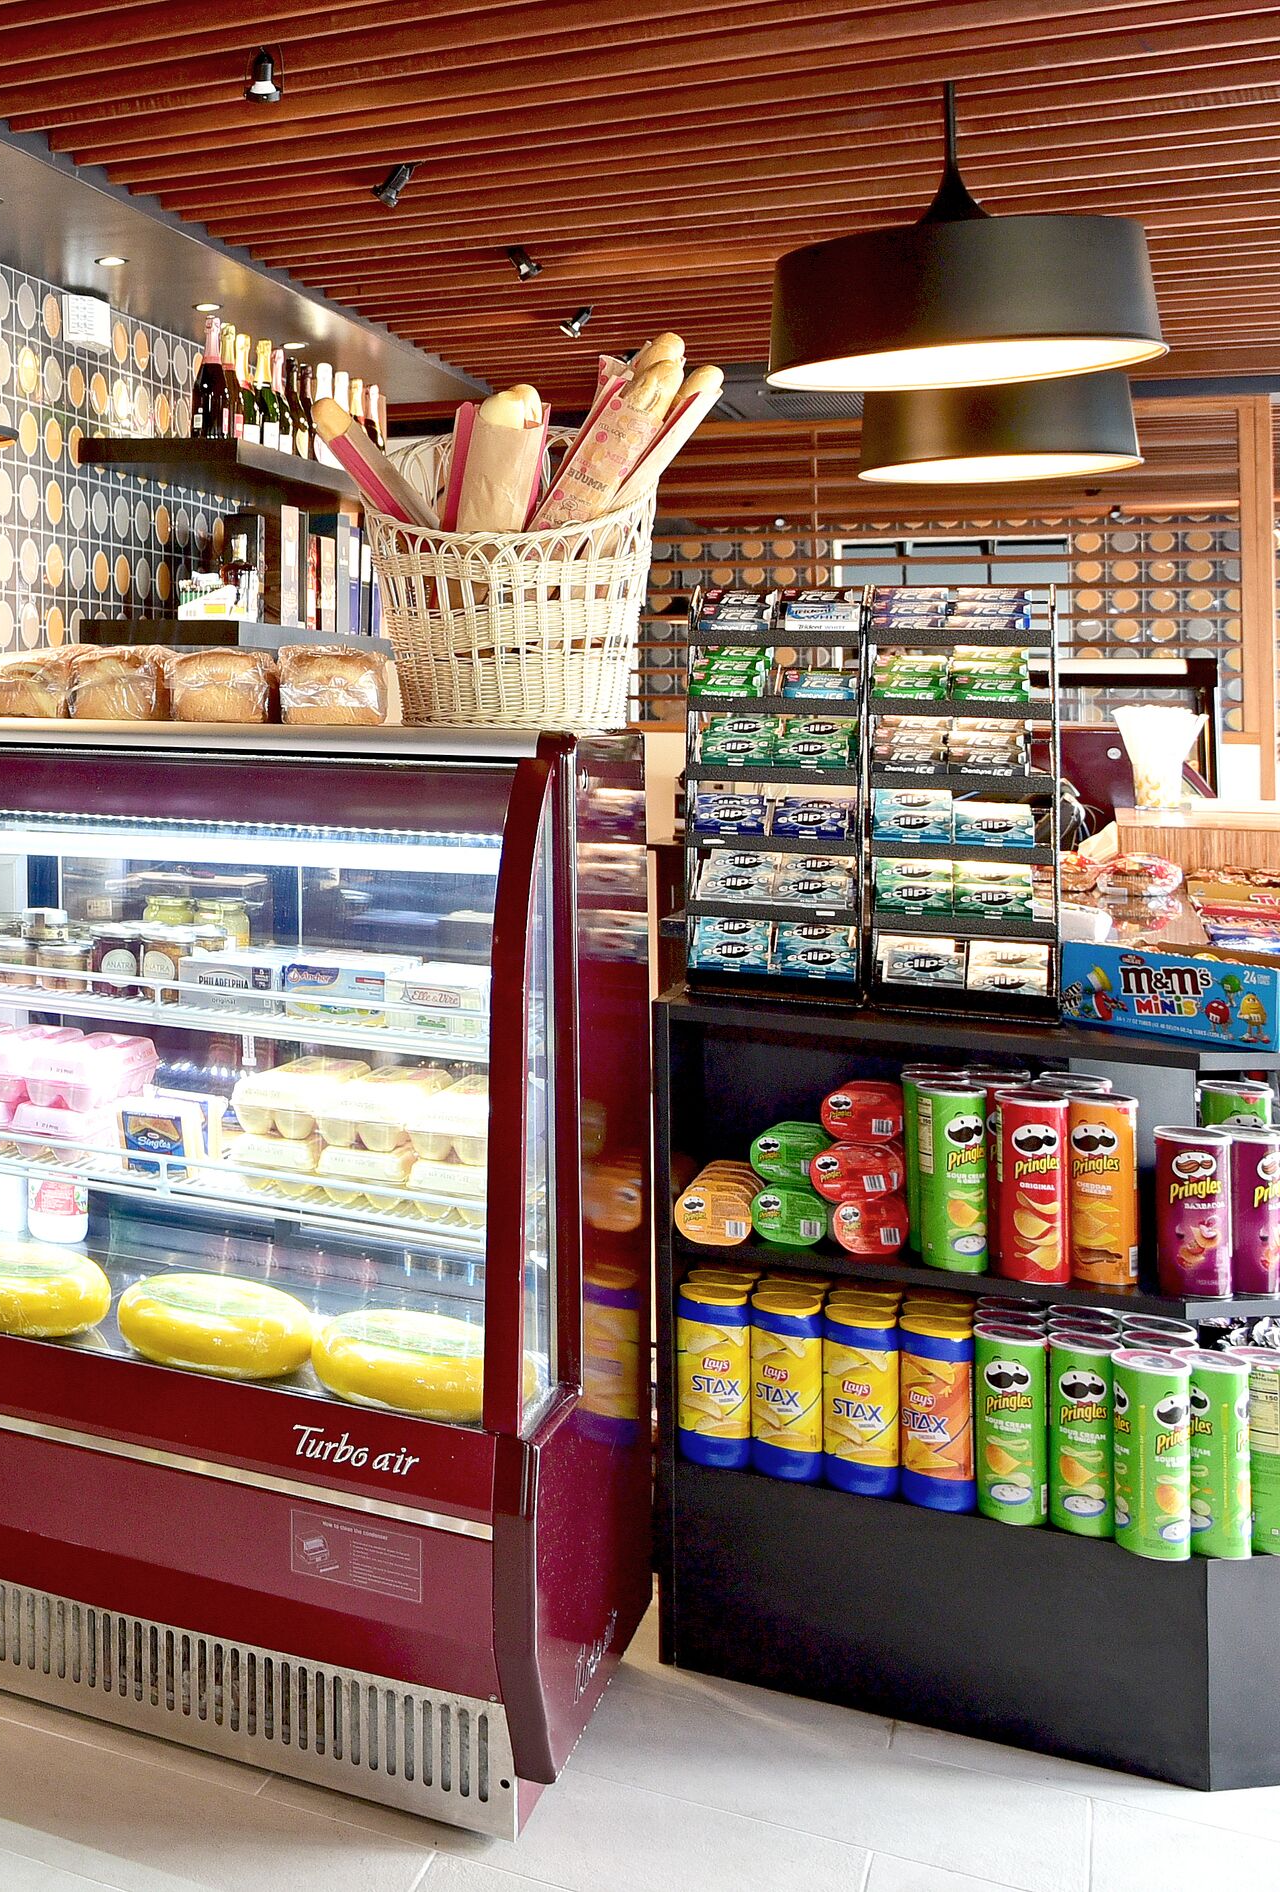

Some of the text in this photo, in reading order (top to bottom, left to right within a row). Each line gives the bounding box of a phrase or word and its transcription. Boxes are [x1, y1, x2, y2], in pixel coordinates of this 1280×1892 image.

[915, 692, 934, 700] ICE
[915, 766, 935, 774] ICE
[960, 767, 1013, 776] Dentyne ICE
[961, 818, 1027, 830] eclipse
[882, 887, 946, 898] eclipse
[960, 891, 1028, 903] eclipse
[703, 944, 763, 955] eclipse
[787, 952, 850, 962] eclipse
[893, 958, 959, 969] eclipse
[105, 959, 135, 971] ANATRA
[198, 974, 249, 991] PHILADELPHIA
[301, 971, 333, 983] Anchor
[1243, 970, 1257, 984] 24
[138, 1136, 170, 1149] Singles
[1014, 1157, 1060, 1180] Pringles
[1072, 1157, 1120, 1178] Pringles
[1019, 1182, 1055, 1191] ORIGINAL
[1077, 1181, 1112, 1191] CHEDDAR
[1081, 1187, 1106, 1195] CHEESE
[1170, 1178, 1222, 1204] Pringles
[1184, 1202, 1225, 1210] BARBACOA
[703, 1359, 730, 1371] Lay's
[763, 1365, 789, 1381] Lay's
[692, 1376, 740, 1396] STAX
[843, 1380, 871, 1396] Lay's
[755, 1383, 799, 1407] STAX
[909, 1391, 934, 1407] Lay's
[832, 1399, 883, 1422] STAX
[986, 1395, 1033, 1415] Pringles
[1060, 1405, 1108, 1424] Pringles
[902, 1409, 948, 1434] STAX
[985, 1416, 1032, 1429] SOUR CREAM
[1000, 1425, 1023, 1434] ONION
[1059, 1426, 1106, 1440] SOUR CREAM
[1074, 1436, 1096, 1444] ONION
[293, 1424, 419, 1476] Turbo air
[340, 1524, 388, 1541] clean condenser
